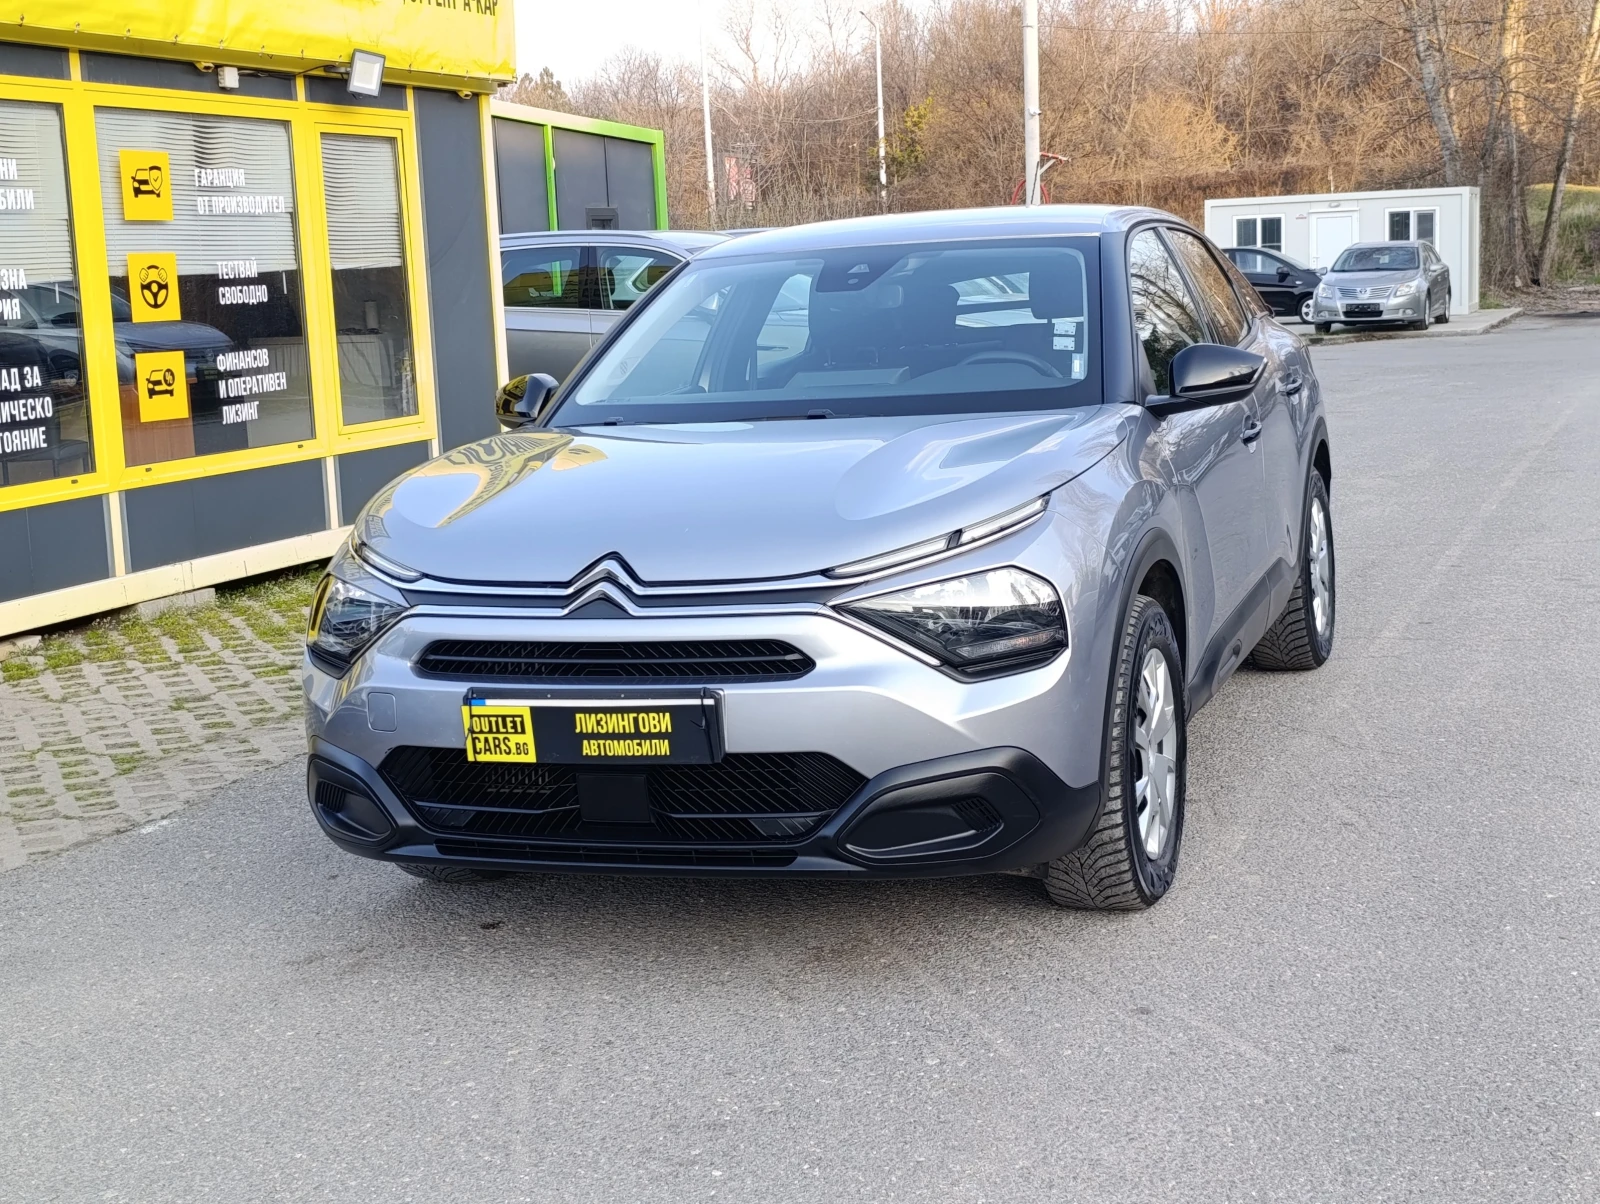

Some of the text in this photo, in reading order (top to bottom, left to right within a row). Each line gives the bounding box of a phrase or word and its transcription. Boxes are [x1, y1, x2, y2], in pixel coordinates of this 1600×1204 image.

[194, 168, 246, 189] ГАРАНЦИЯ
[197, 195, 285, 215] ОТ ПРОИЗВОДИТЕЛ
[0, 268, 28, 290] ЗНА
[216, 256, 258, 280] ТЕСТВАЙ
[218, 284, 269, 306] СВОБОДНО
[216, 348, 270, 373] ФИНАНСОВ
[0, 365, 42, 392] АД ЗА
[218, 379, 227, 399] И
[227, 371, 287, 398] ОПЕРАТИВЕН
[0, 396, 53, 424] ИЧЕСКО
[222, 400, 260, 425] ЛИЗИНГ
[472, 716, 522, 733] OUTLET
[575, 712, 672, 734] ЛИЗИНГОВИ
[582, 739, 670, 756] АВТОМОБИЛИ
